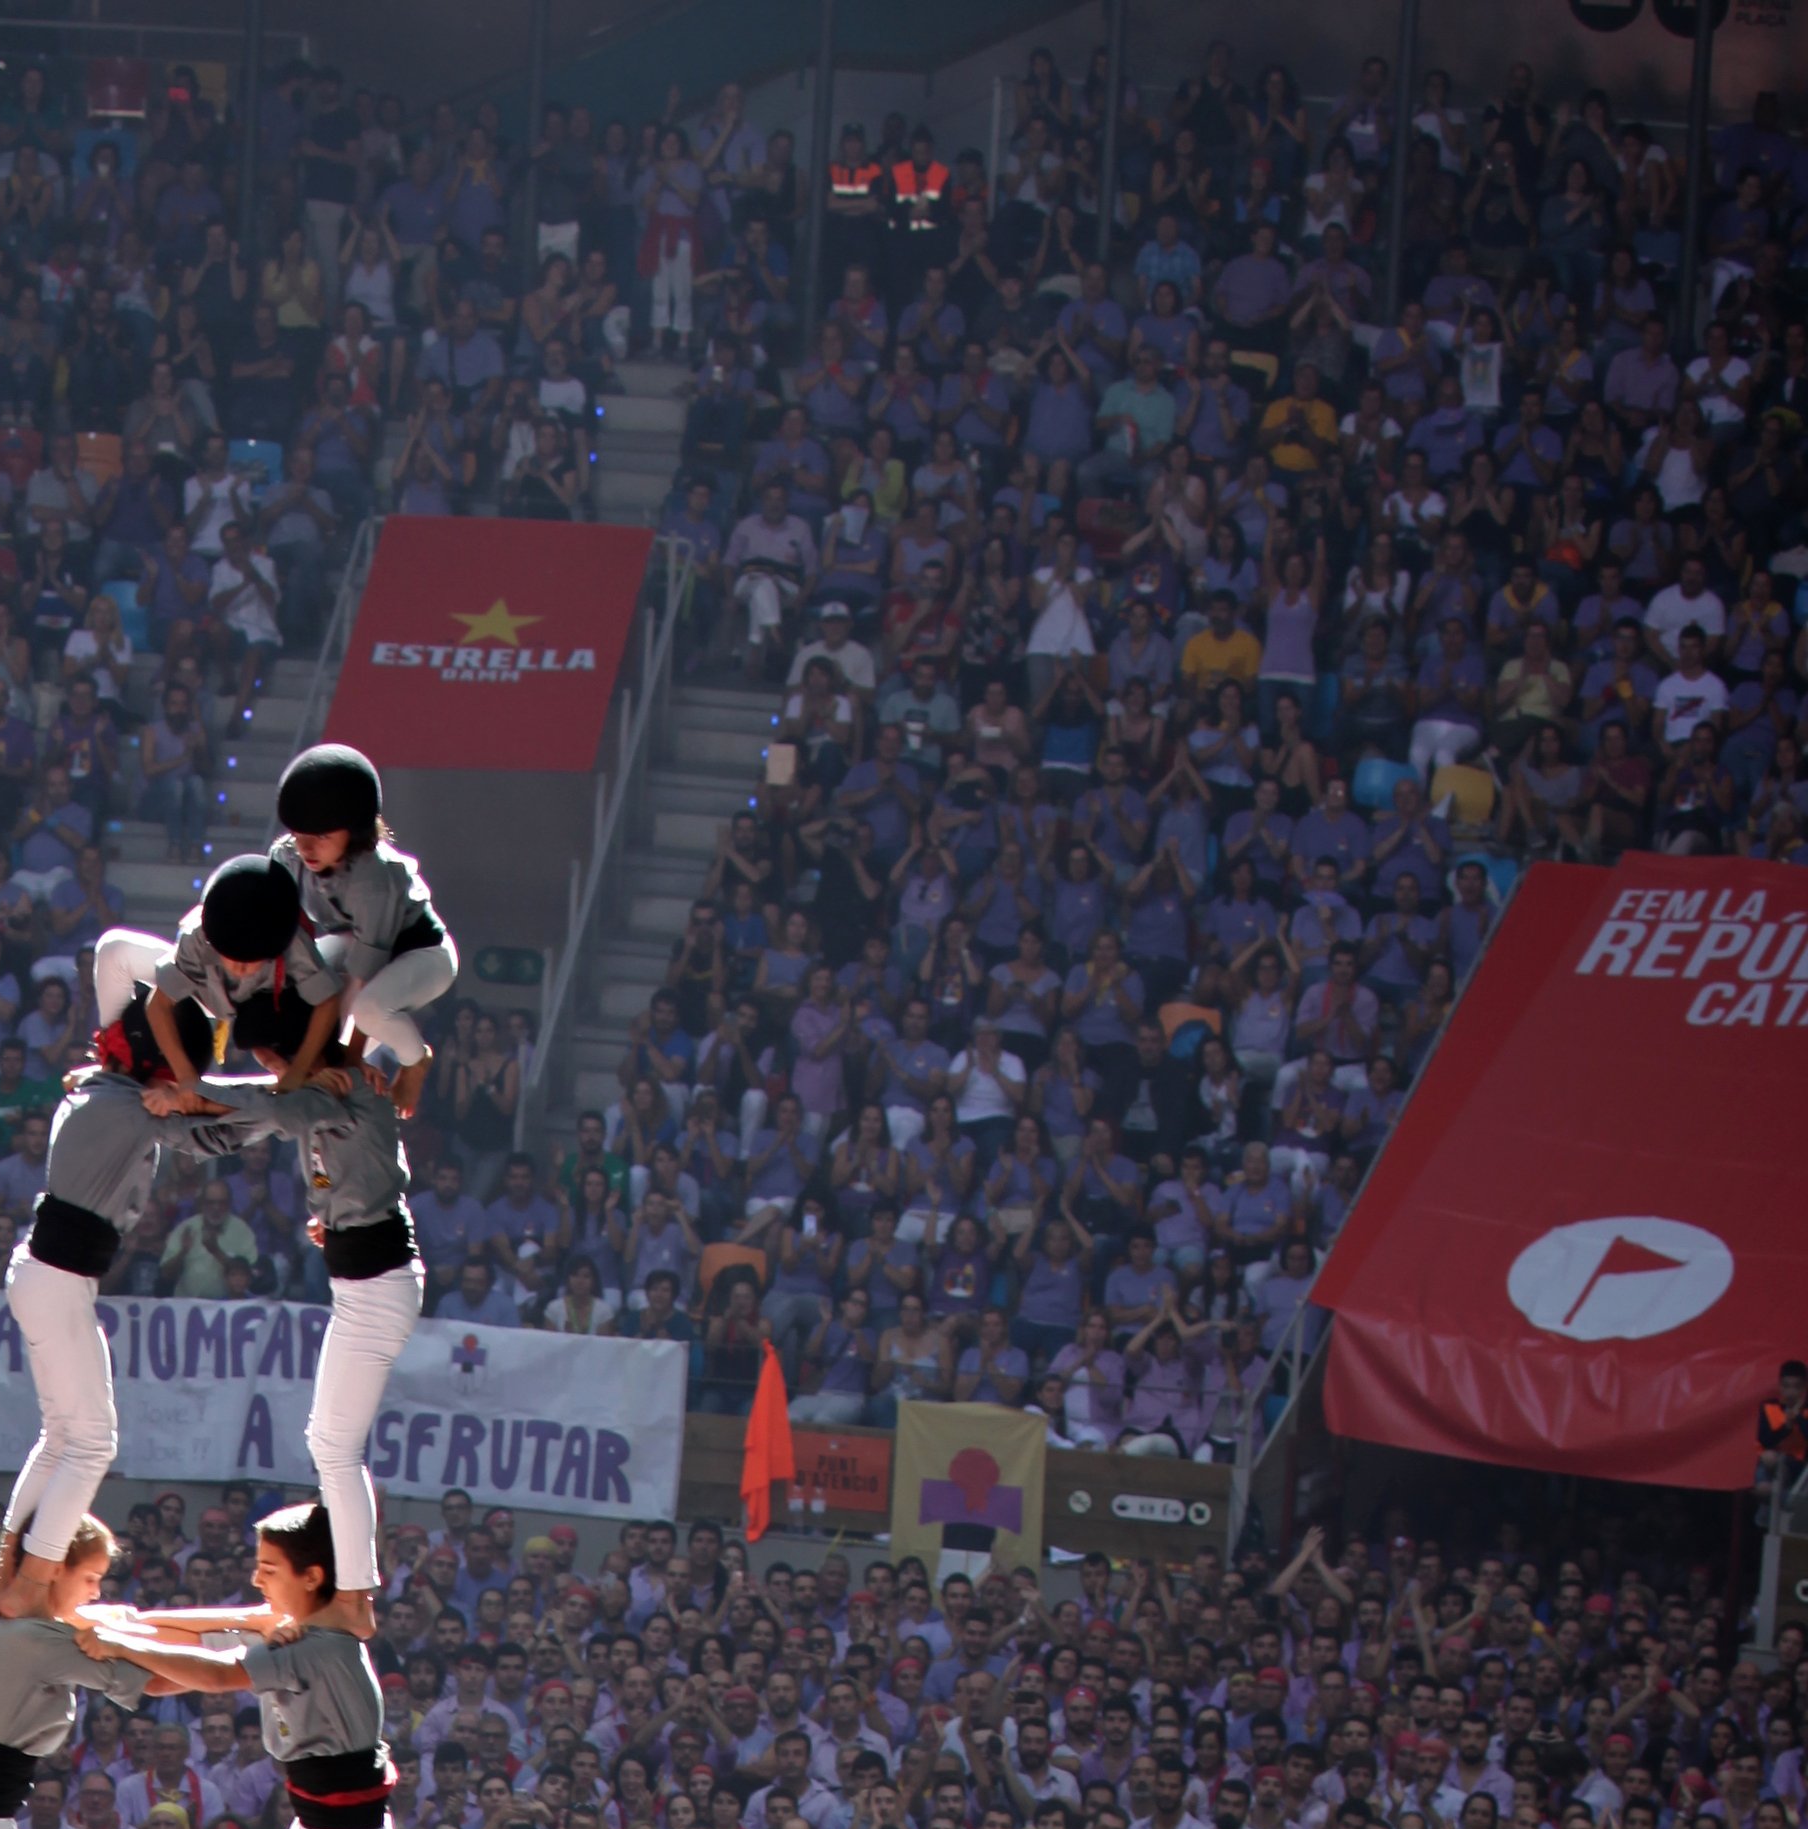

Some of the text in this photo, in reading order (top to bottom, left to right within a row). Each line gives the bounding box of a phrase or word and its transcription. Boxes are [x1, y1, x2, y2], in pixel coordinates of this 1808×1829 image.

[371, 642, 597, 671] ESTRELLA
[441, 668, 521, 683] DAMM
[1608, 888, 1768, 922] FEM LA
[817, 1454, 858, 1474] PUNT
